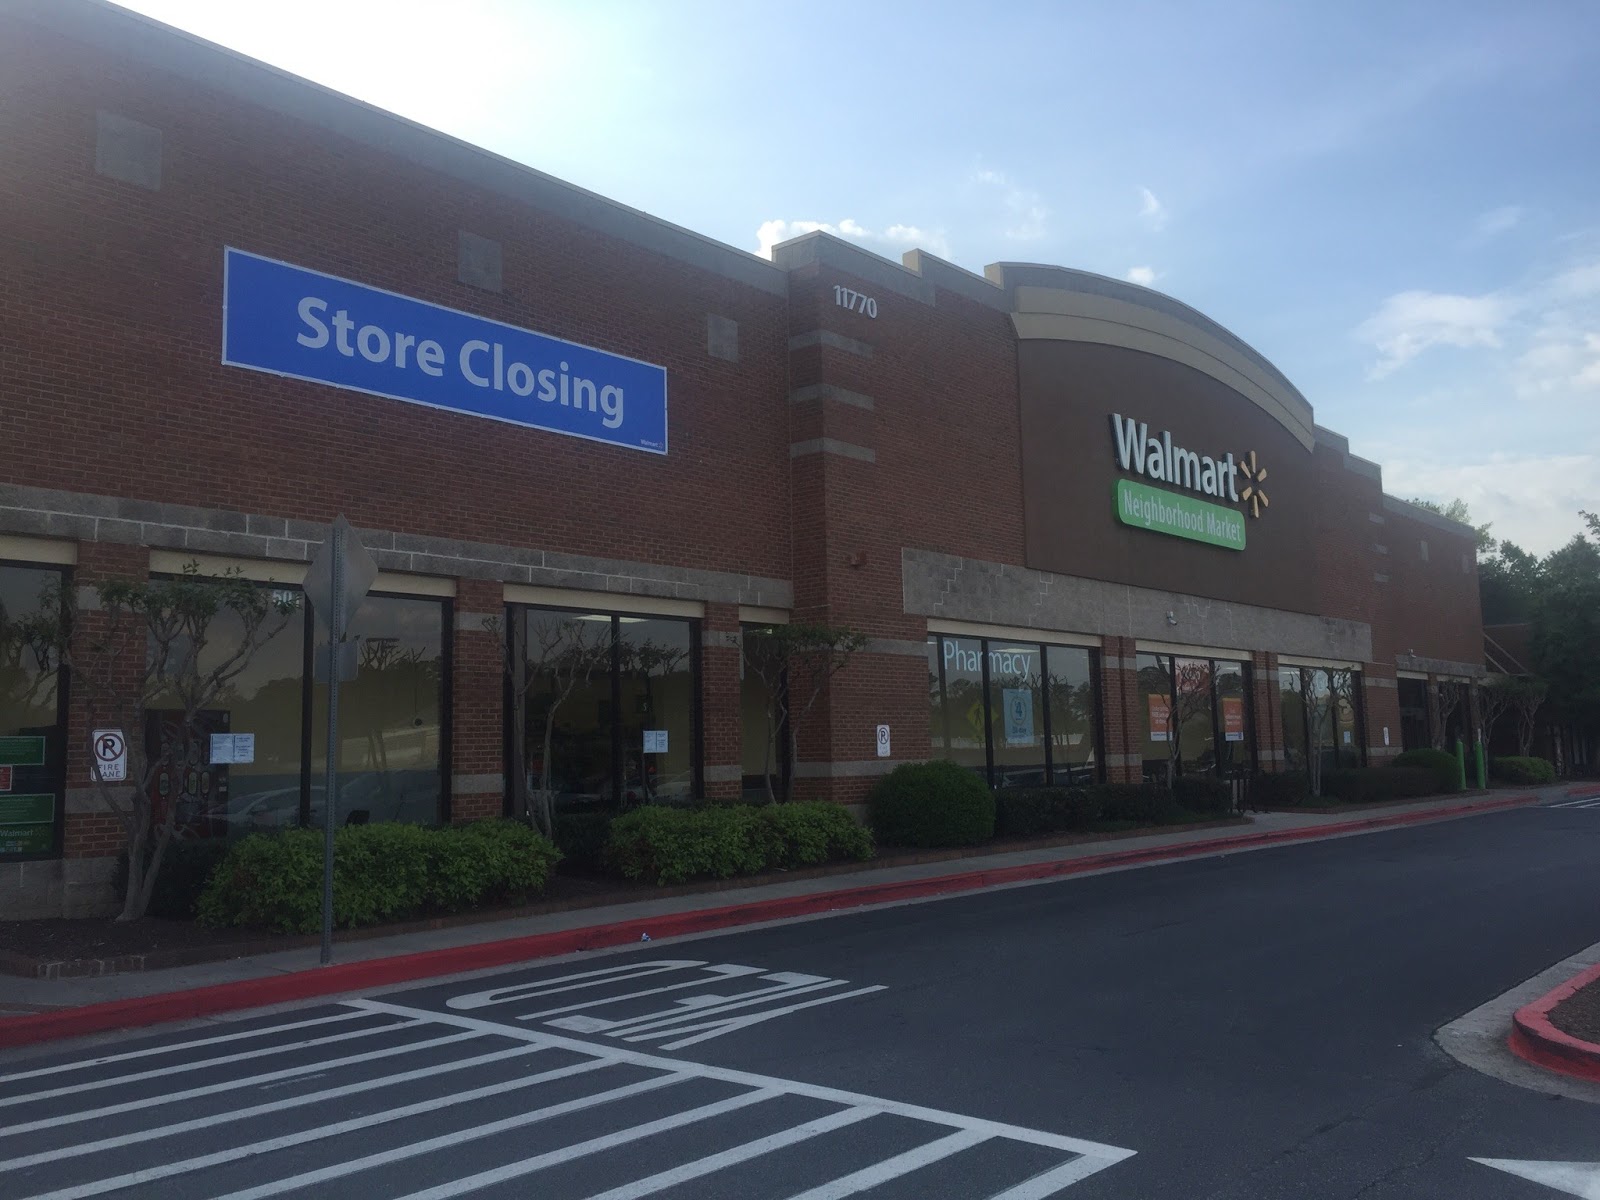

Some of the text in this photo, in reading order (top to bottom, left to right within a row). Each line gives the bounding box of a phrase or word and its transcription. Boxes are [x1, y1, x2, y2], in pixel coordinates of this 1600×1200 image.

[833, 284, 878, 319] 11770
[297, 296, 625, 429] Store Closing
[1110, 413, 1239, 502] Walmart
[1123, 489, 1241, 542] Neighborhood Market
[944, 640, 1030, 682] Pharmacy
[0, 829, 34, 838] Walmart
